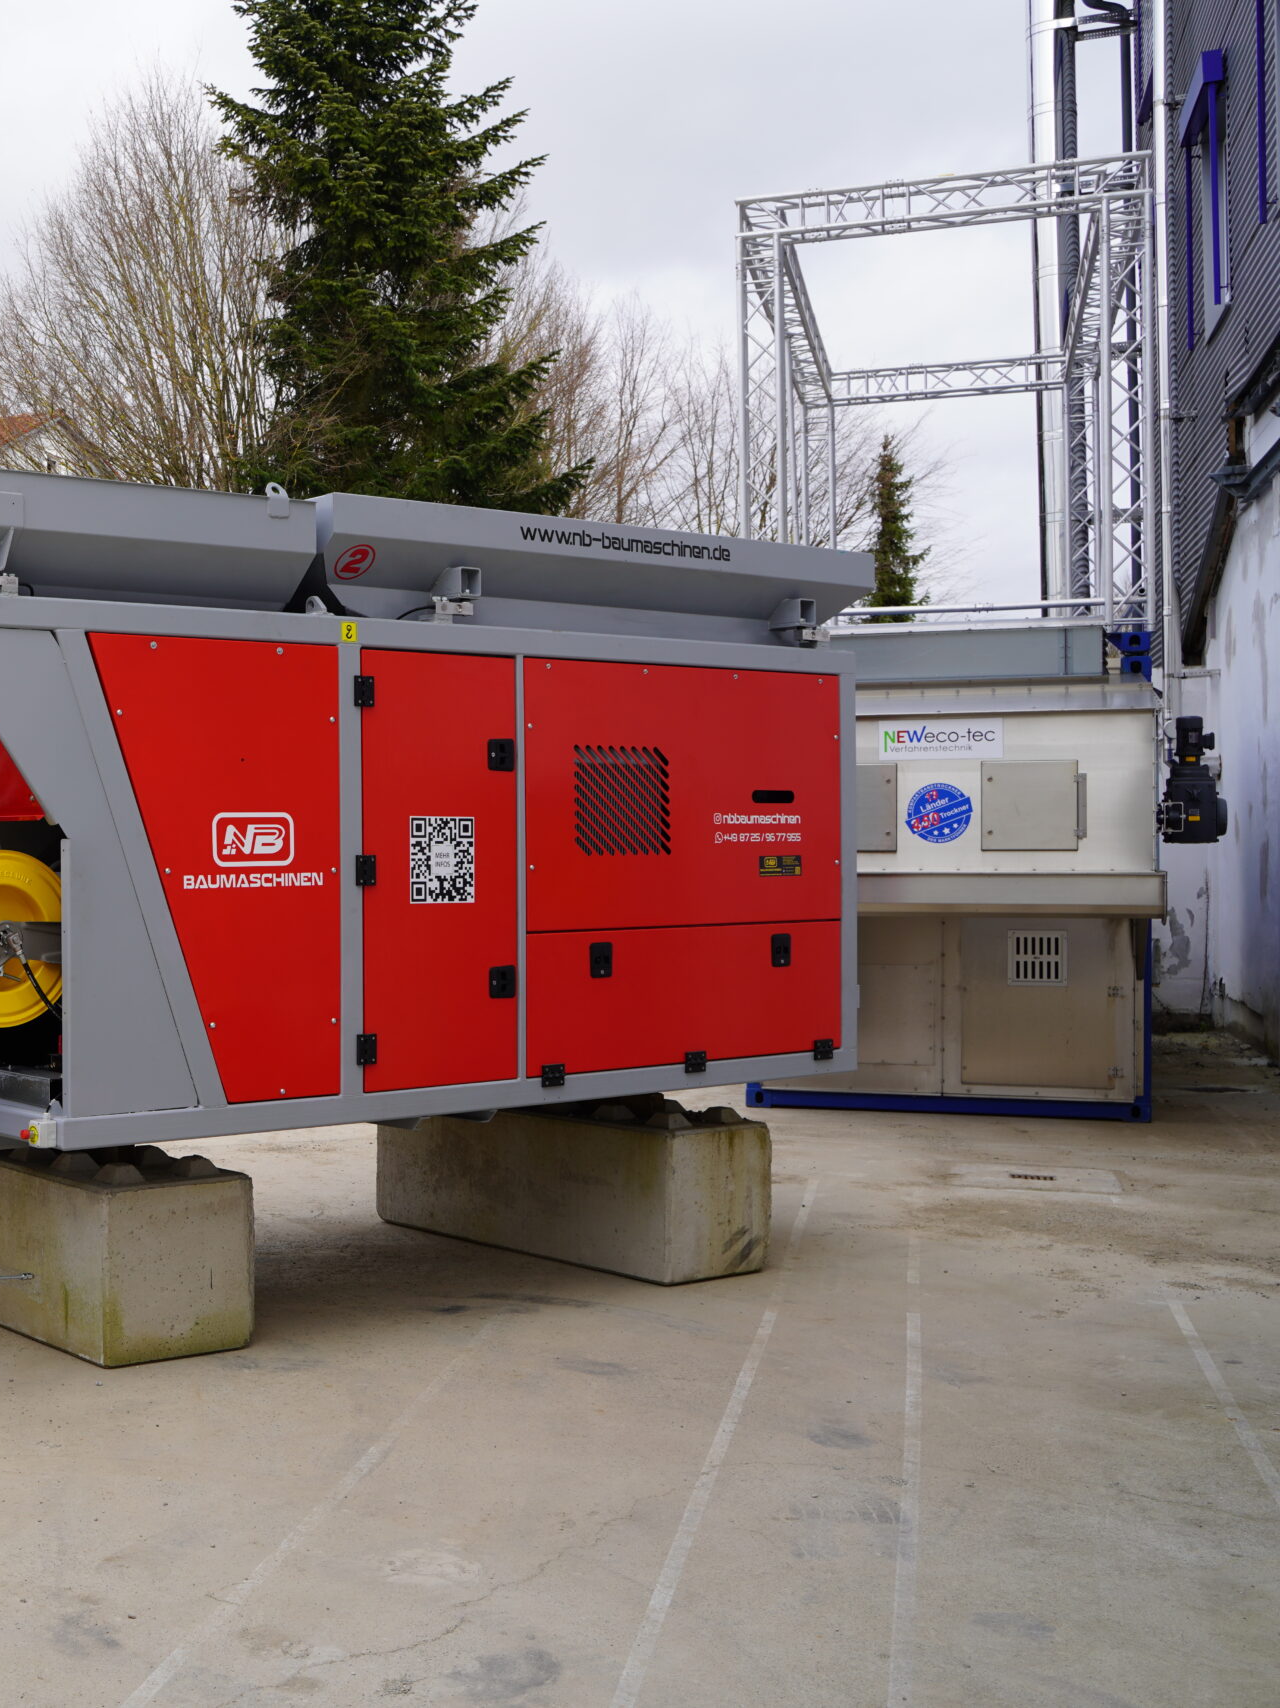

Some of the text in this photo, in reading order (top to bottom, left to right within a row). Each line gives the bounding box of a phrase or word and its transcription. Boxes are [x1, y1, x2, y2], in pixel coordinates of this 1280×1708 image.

[520, 526, 731, 562] www.nb-baumaschinen.de
[339, 548, 370, 574] 2
[889, 744, 973, 753] Verfahrenstechnik
[920, 797, 949, 813] Länder
[939, 804, 969, 819] Trockner
[723, 813, 801, 824] nbbaumaschinen
[222, 824, 286, 855] NB
[183, 872, 324, 889] BAUMASCHINEN
